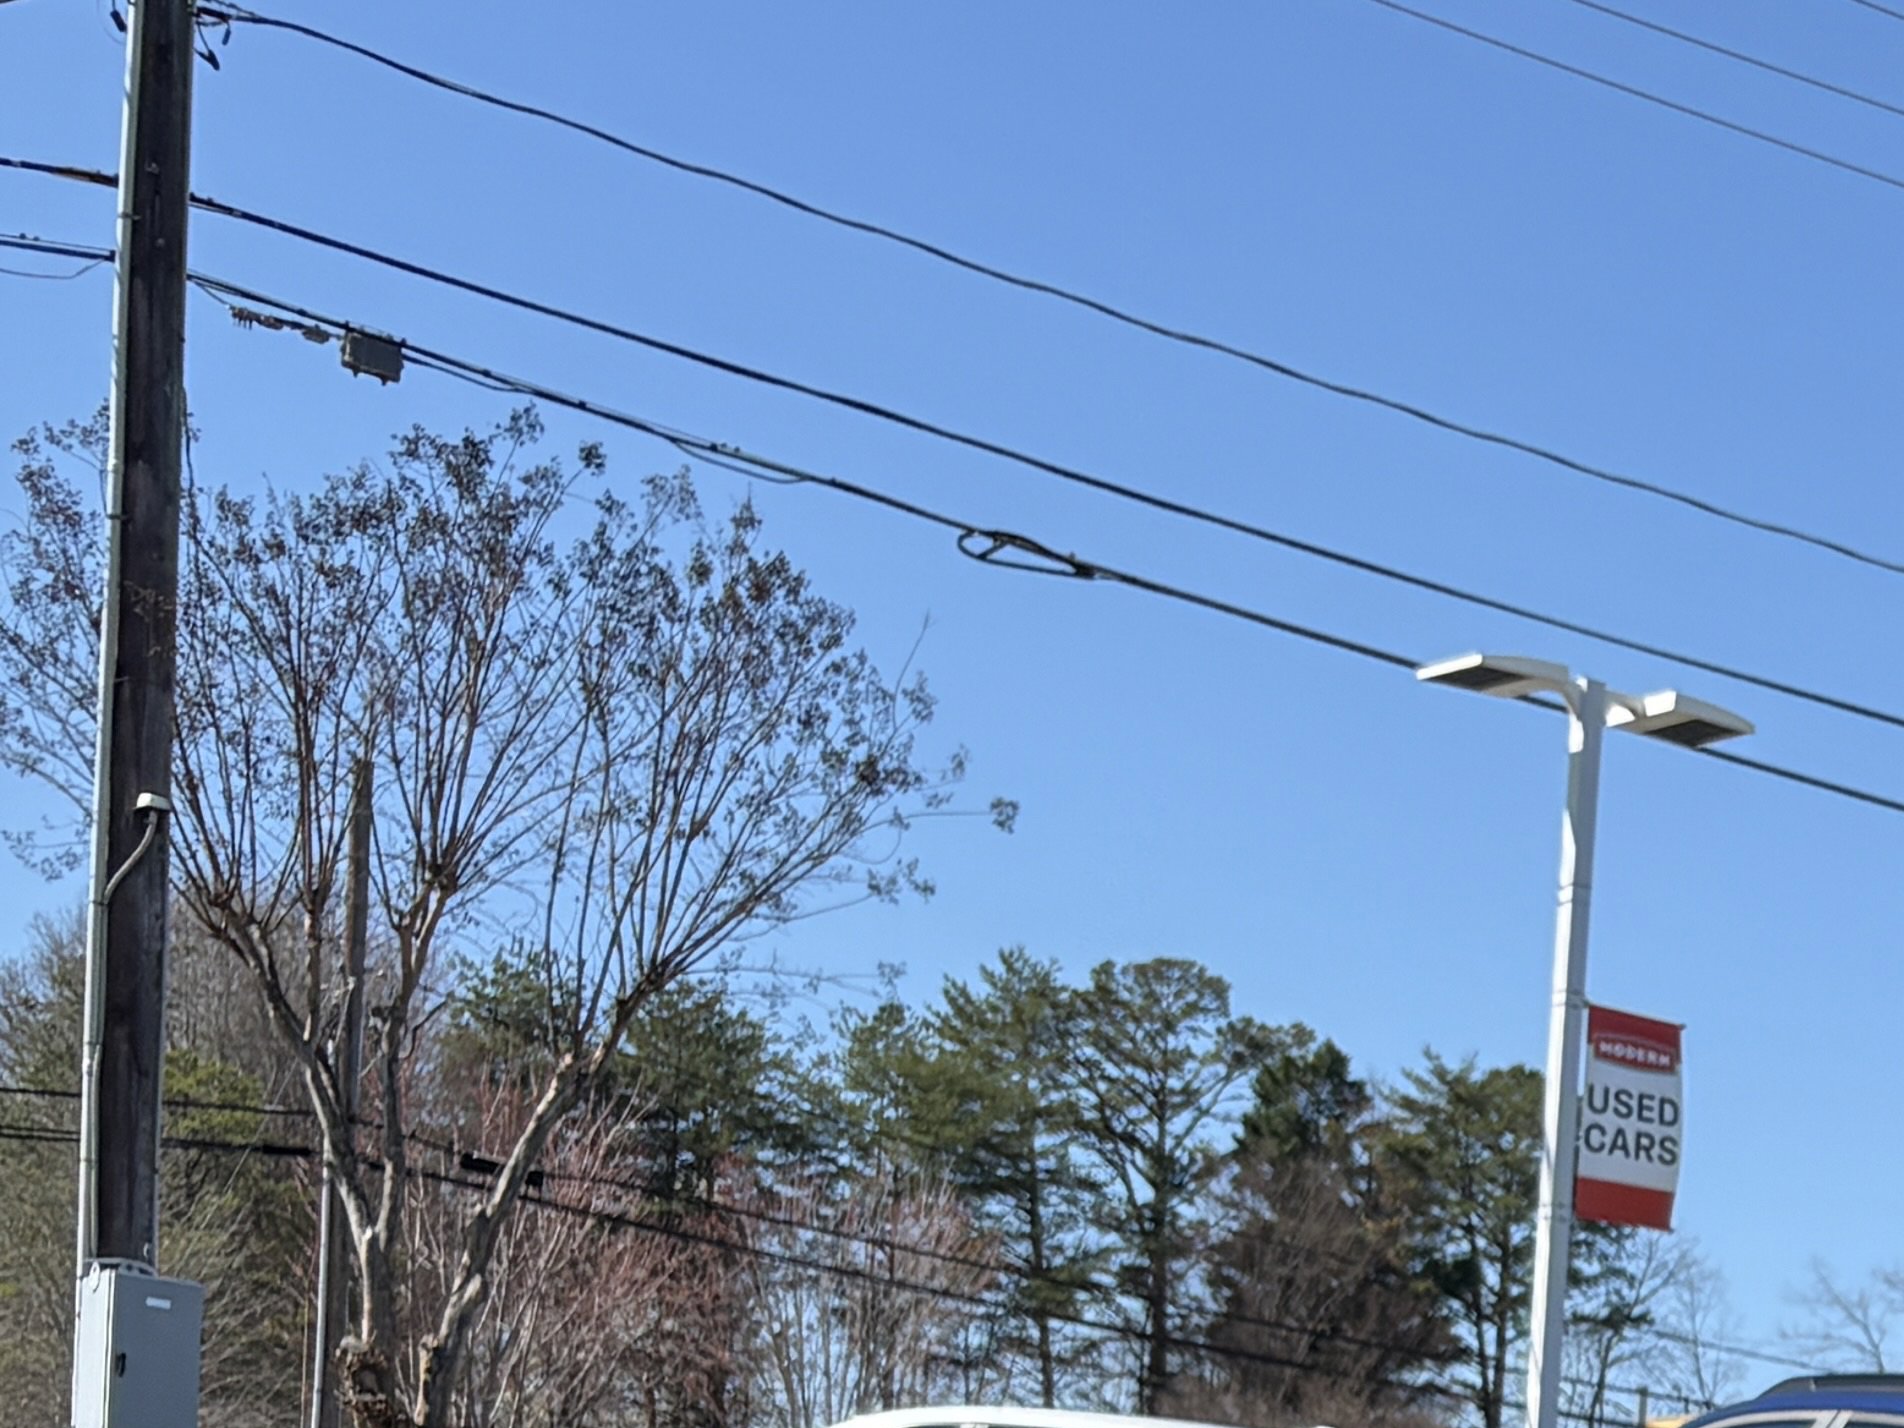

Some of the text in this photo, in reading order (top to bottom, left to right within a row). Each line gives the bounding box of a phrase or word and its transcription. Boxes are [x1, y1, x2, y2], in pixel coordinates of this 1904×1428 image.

[1599, 1040, 1670, 1066] MODERN
[1587, 1083, 1679, 1127] USED
[1584, 1122, 1678, 1166] CARS
